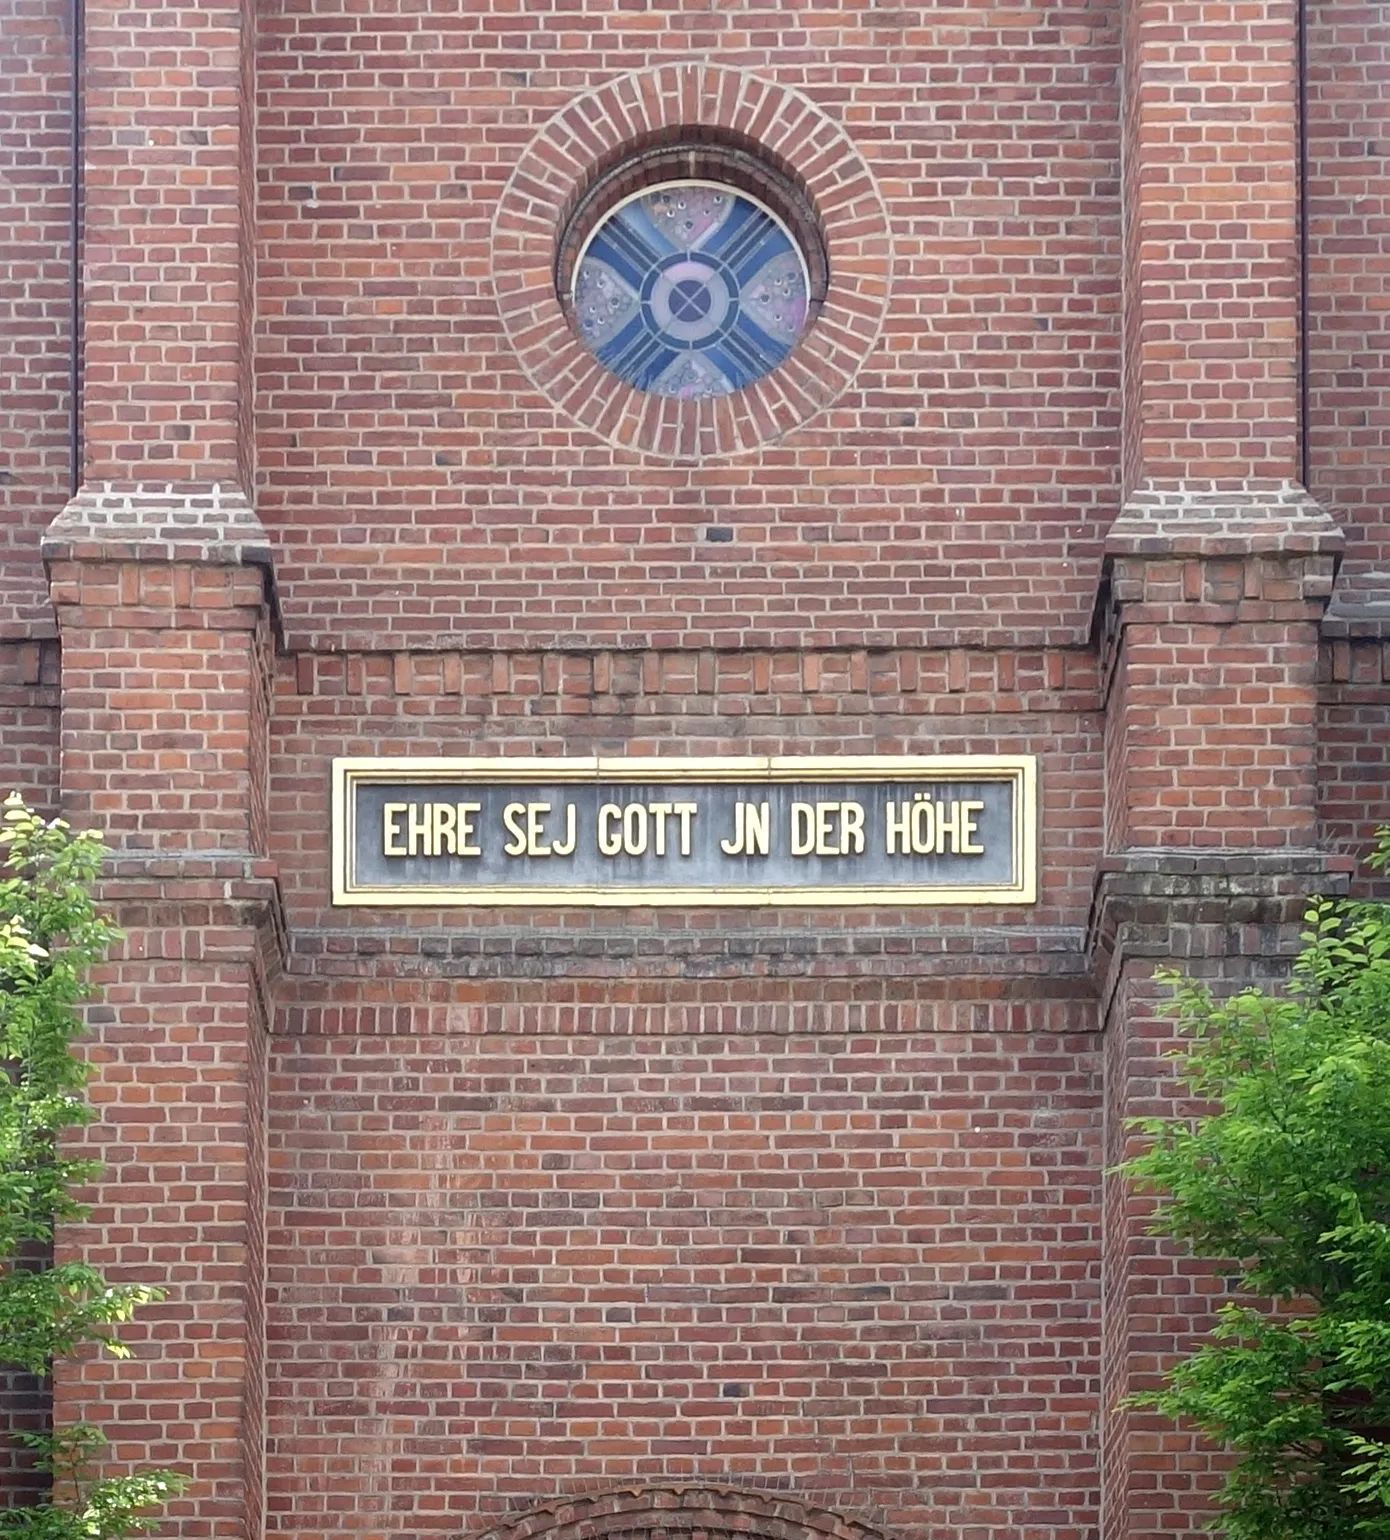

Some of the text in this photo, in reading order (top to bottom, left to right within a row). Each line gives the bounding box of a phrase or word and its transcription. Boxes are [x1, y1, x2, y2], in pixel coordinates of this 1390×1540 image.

[384, 803, 481, 856] EHRE
[598, 802, 697, 856] GOTT
[790, 802, 866, 855] DER
[886, 793, 985, 855] HÖHE
